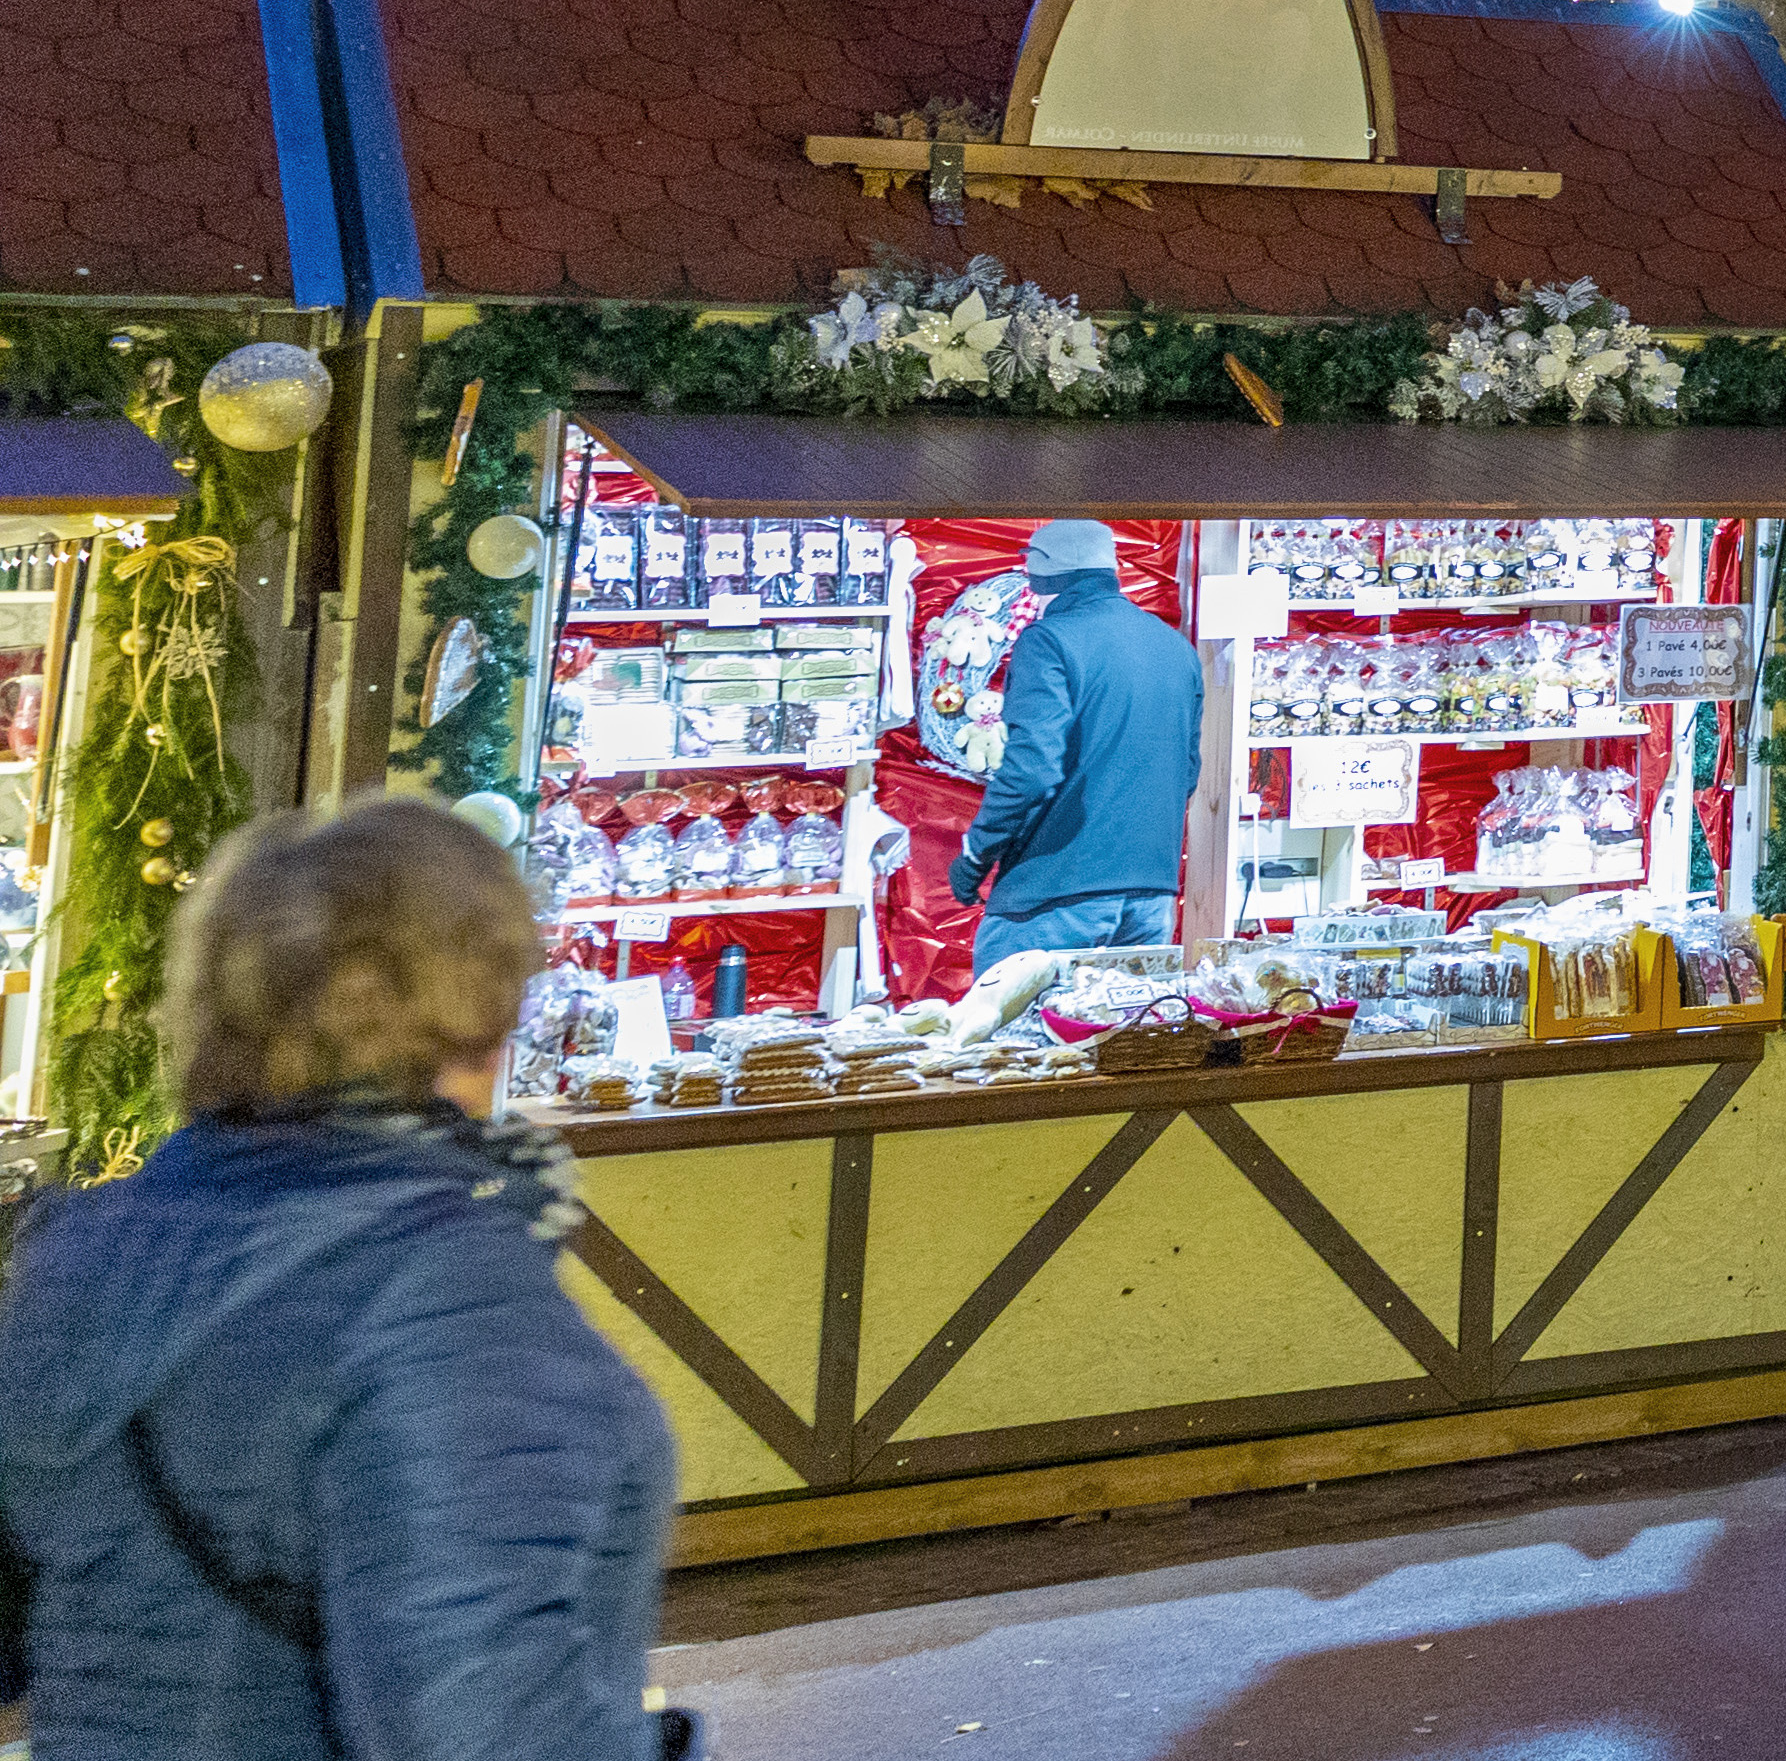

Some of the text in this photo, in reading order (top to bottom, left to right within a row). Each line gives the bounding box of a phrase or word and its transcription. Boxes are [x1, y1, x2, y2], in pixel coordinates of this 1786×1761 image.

[1646, 639, 1727, 653] 1 Pavé 4,00€
[1637, 665, 1733, 679] 3 Pavés 10,00€
[1348, 778, 1400, 791] sachets
